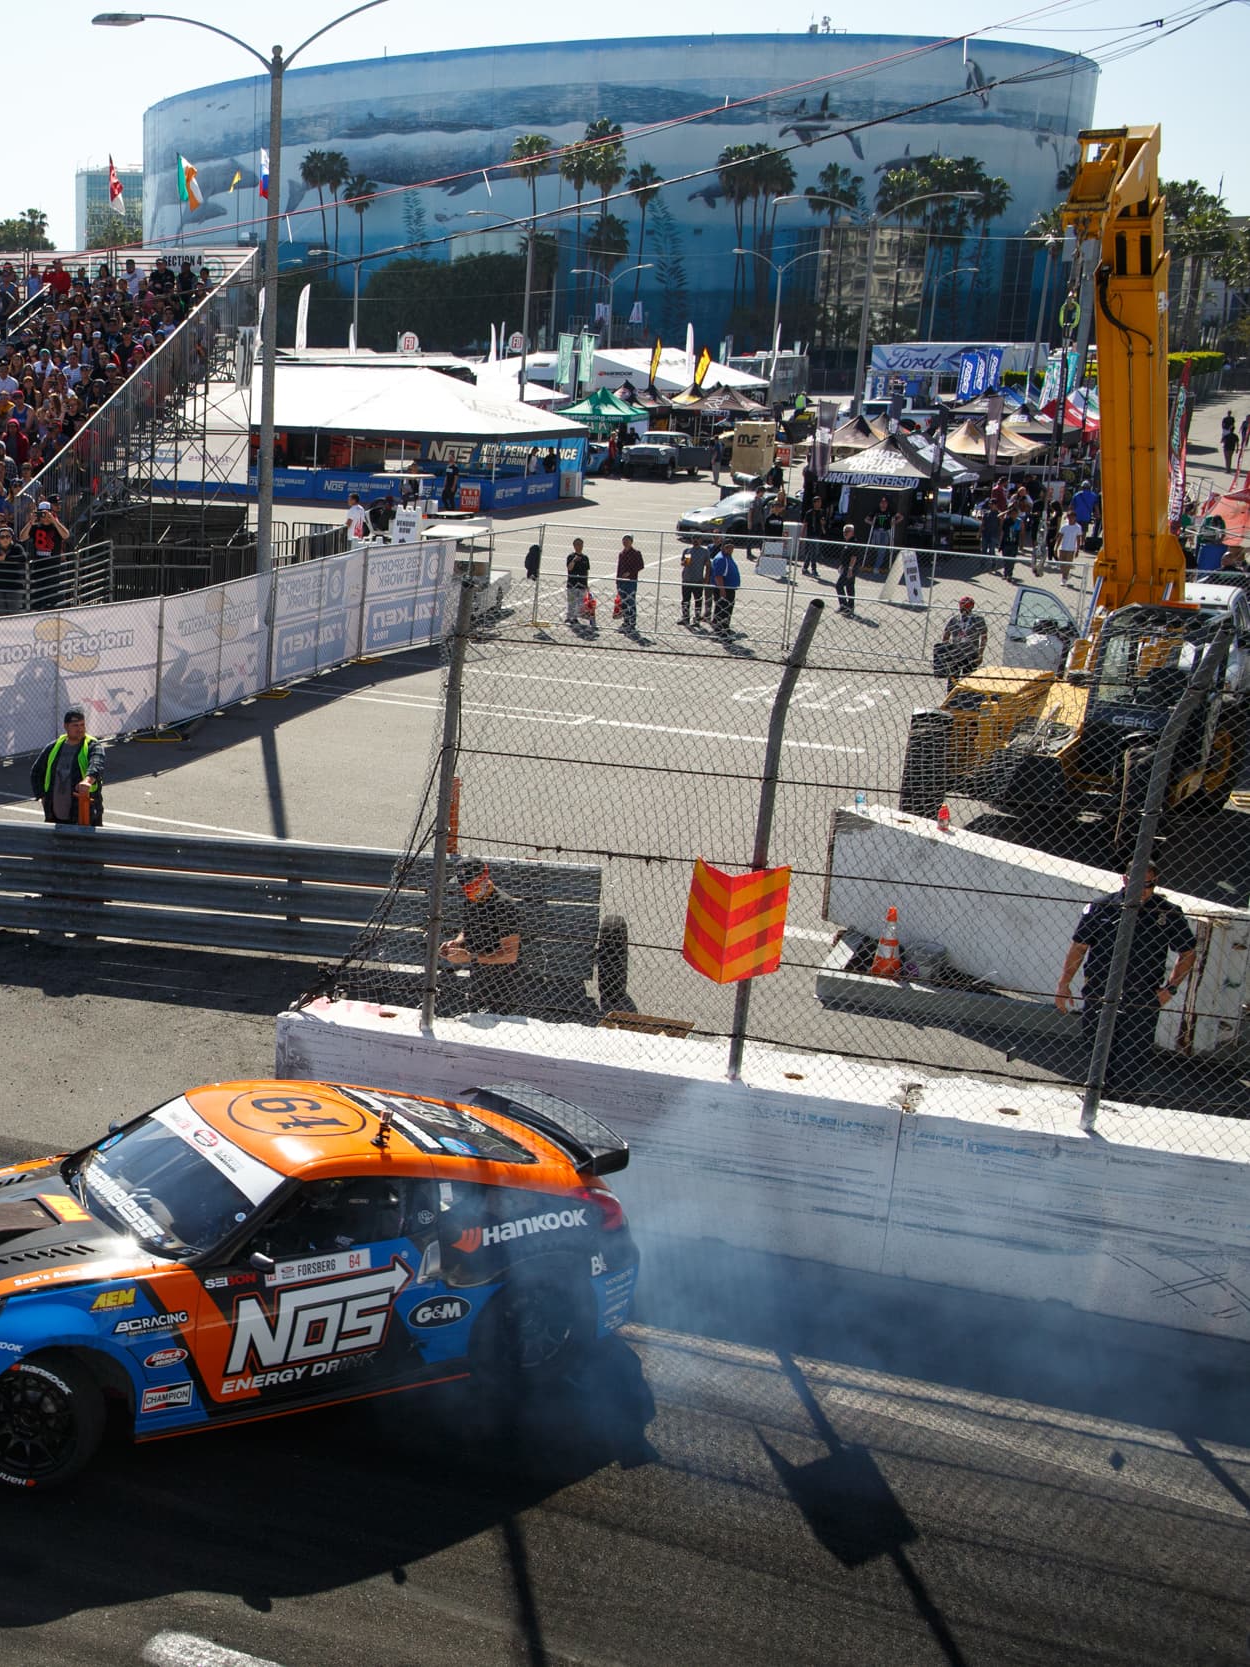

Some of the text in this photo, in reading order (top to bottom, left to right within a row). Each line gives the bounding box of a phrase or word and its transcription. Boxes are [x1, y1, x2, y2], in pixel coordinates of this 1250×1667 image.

[886, 347, 942, 369] Ford
[428, 441, 478, 464] NOS
[324, 480, 347, 492] NOS
[1112, 715, 1155, 729] GEHL
[297, 1258, 336, 1277] FORSBERG
[349, 1253, 361, 1269] 64
[91, 1287, 136, 1310] AEM
[225, 1270, 402, 1374] NOS
[416, 1302, 462, 1324] G&M
[221, 1367, 307, 1394] ENERGY
[146, 1391, 188, 1404] CHAMPION
